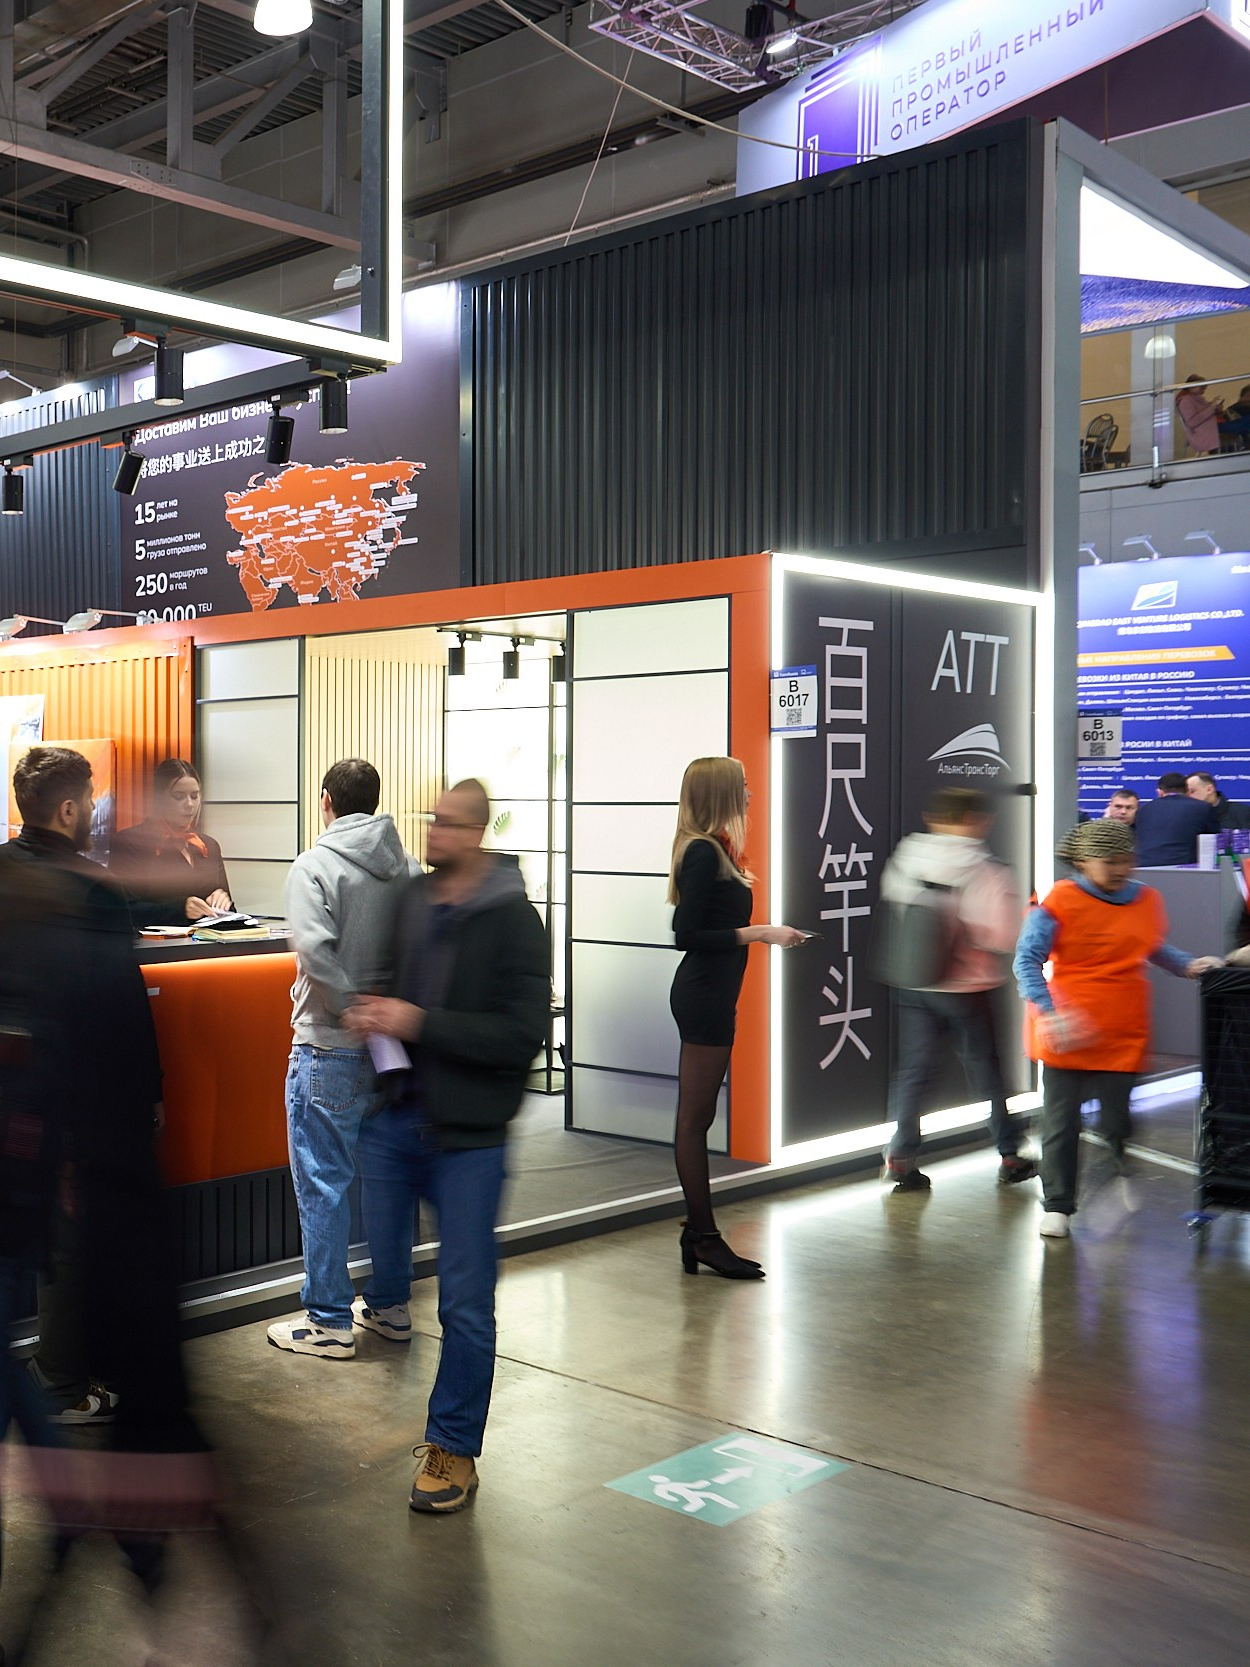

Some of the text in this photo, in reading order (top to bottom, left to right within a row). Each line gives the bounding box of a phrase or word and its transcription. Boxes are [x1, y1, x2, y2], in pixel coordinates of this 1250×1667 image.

[893, 28, 982, 93] ПЕРВЫЙ
[890, 70, 1007, 141] ОПЕРАТОР
[232, 400, 274, 421] бизне
[156, 499, 178, 510] лет на
[135, 501, 156, 525] 15
[156, 511, 178, 523] рынке
[146, 532, 201, 547] миллионов тонн
[135, 539, 146, 561] 5
[146, 543, 207, 560] груза отправлено
[169, 567, 208, 580] маршрутов
[135, 572, 168, 597] 250
[175, 582, 188, 591] год
[198, 602, 213, 612] TEU
[930, 629, 1010, 696] ATT
[1077, 675, 1108, 684] ЕВОЗКИ
[1122, 673, 1149, 682] КИТАЯ
[1158, 670, 1196, 680] РОССИЮ
[779, 693, 810, 708] 6017
[1082, 730, 1114, 742] 6013
[1163, 739, 1192, 748] КИТАЙ
[818, 616, 874, 1071] 百尺竿头
